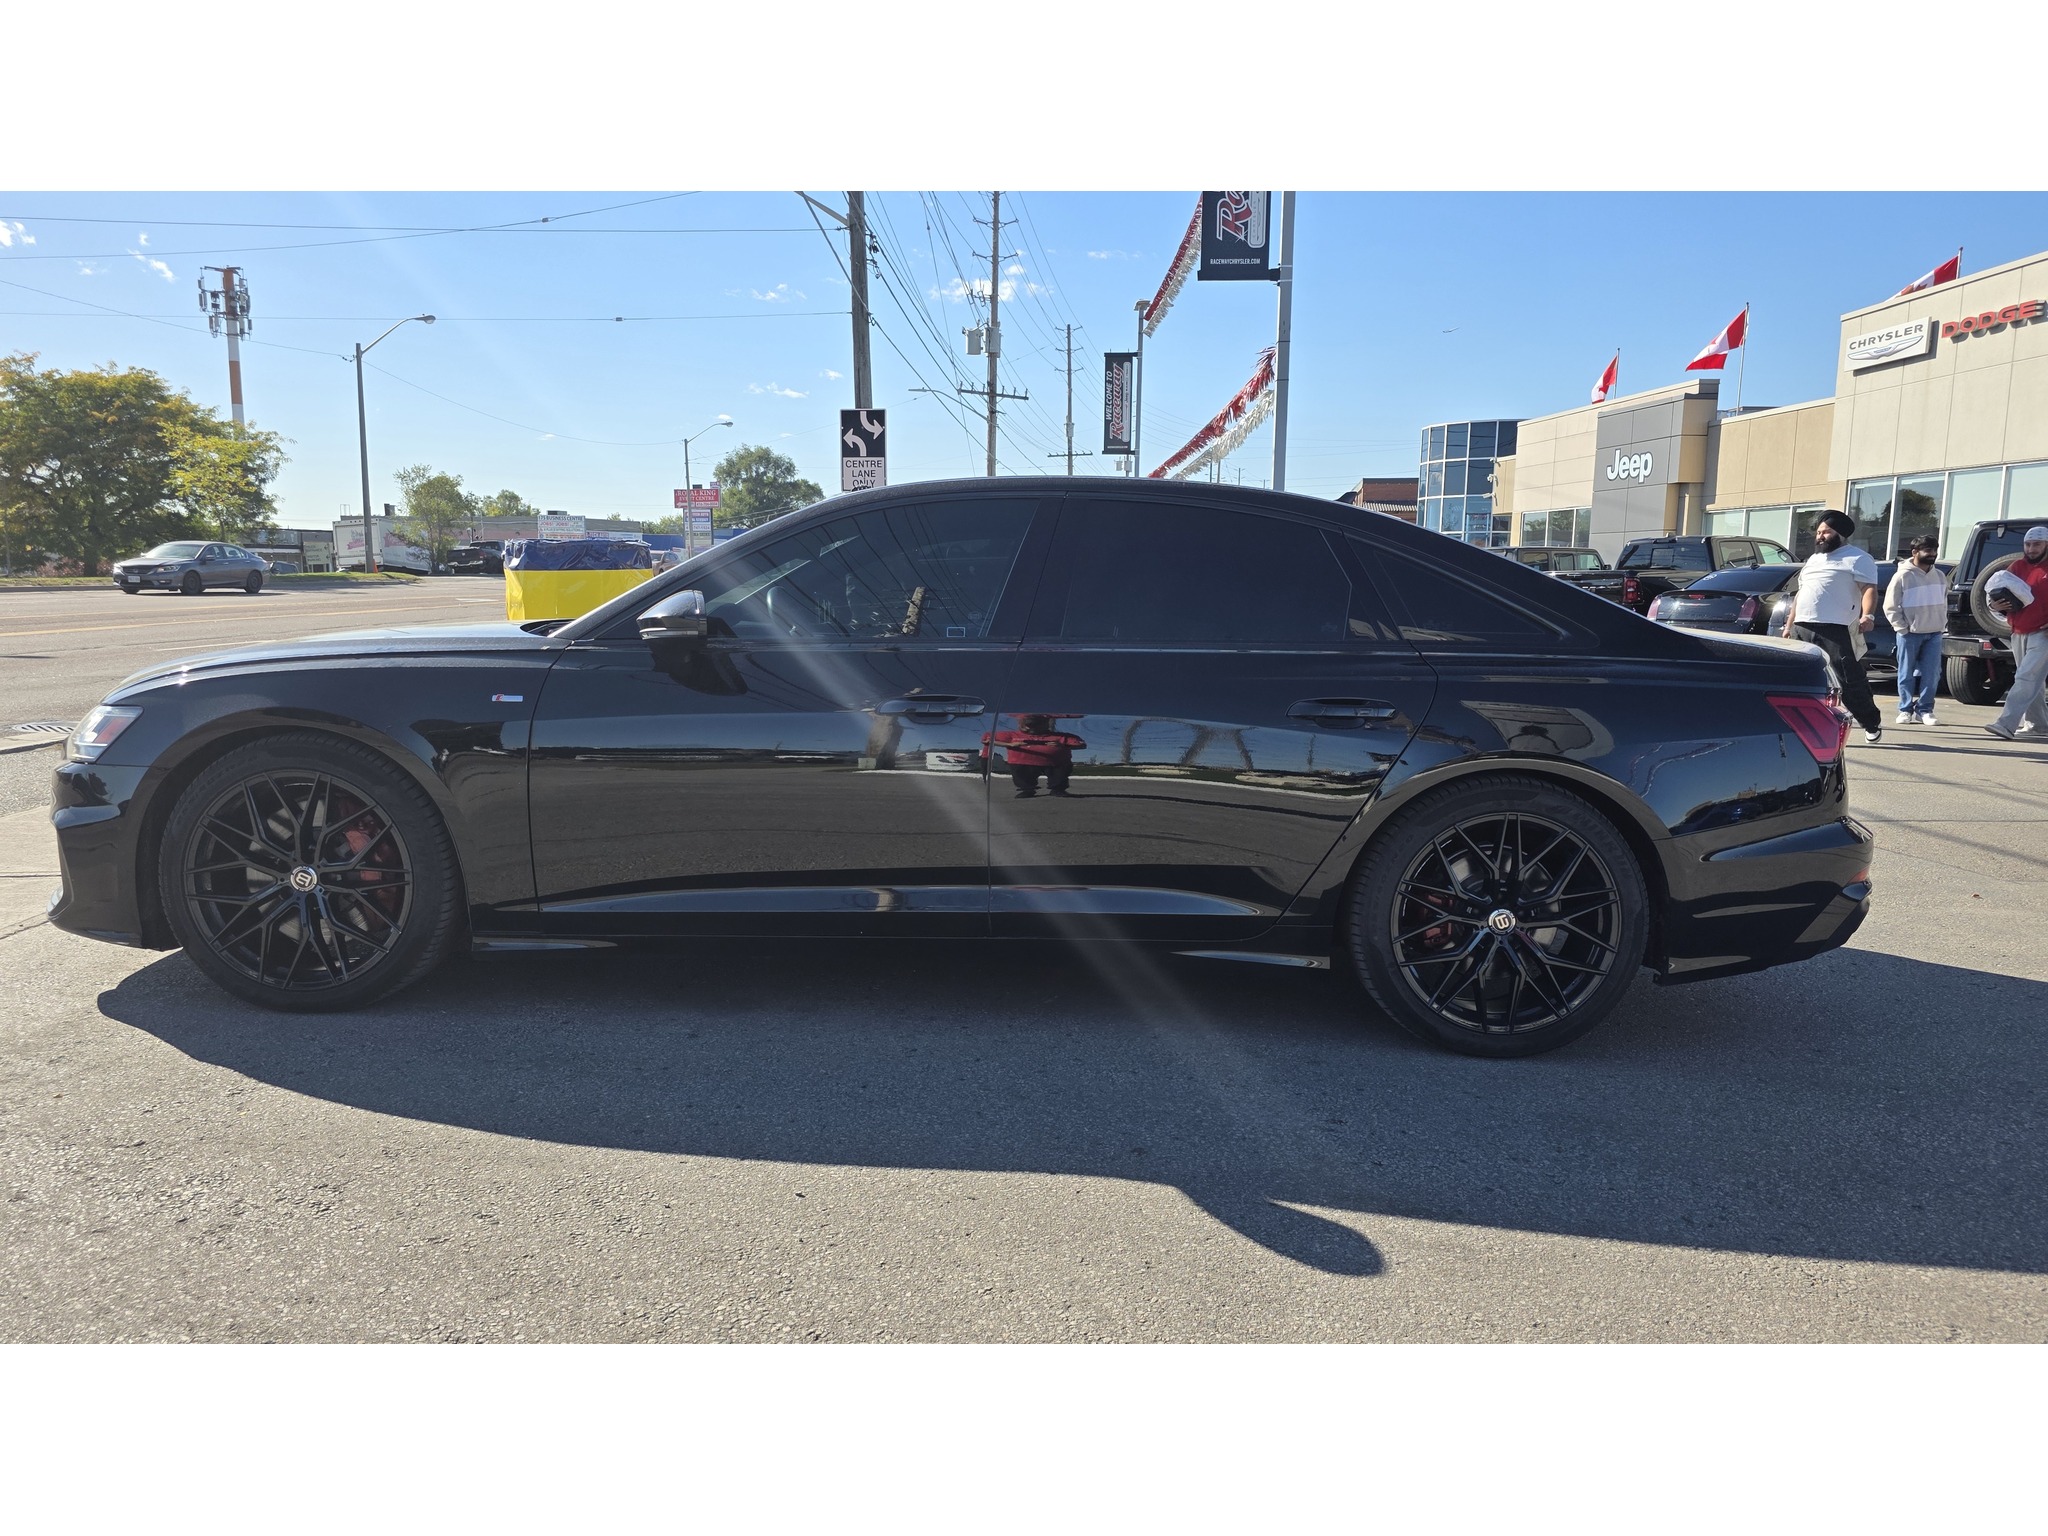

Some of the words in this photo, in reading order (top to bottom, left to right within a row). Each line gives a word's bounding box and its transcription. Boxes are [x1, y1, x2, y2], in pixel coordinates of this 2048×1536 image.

[1941, 300, 2040, 339] DODGE
[1849, 323, 1924, 350] CHRYSLER
[1106, 370, 1113, 382] TO
[1105, 382, 1113, 420] WELCOME
[1109, 363, 1125, 440] Raceway
[845, 460, 883, 468] CENTRE
[852, 470, 876, 478] LANE
[1606, 448, 1653, 484] Jeep
